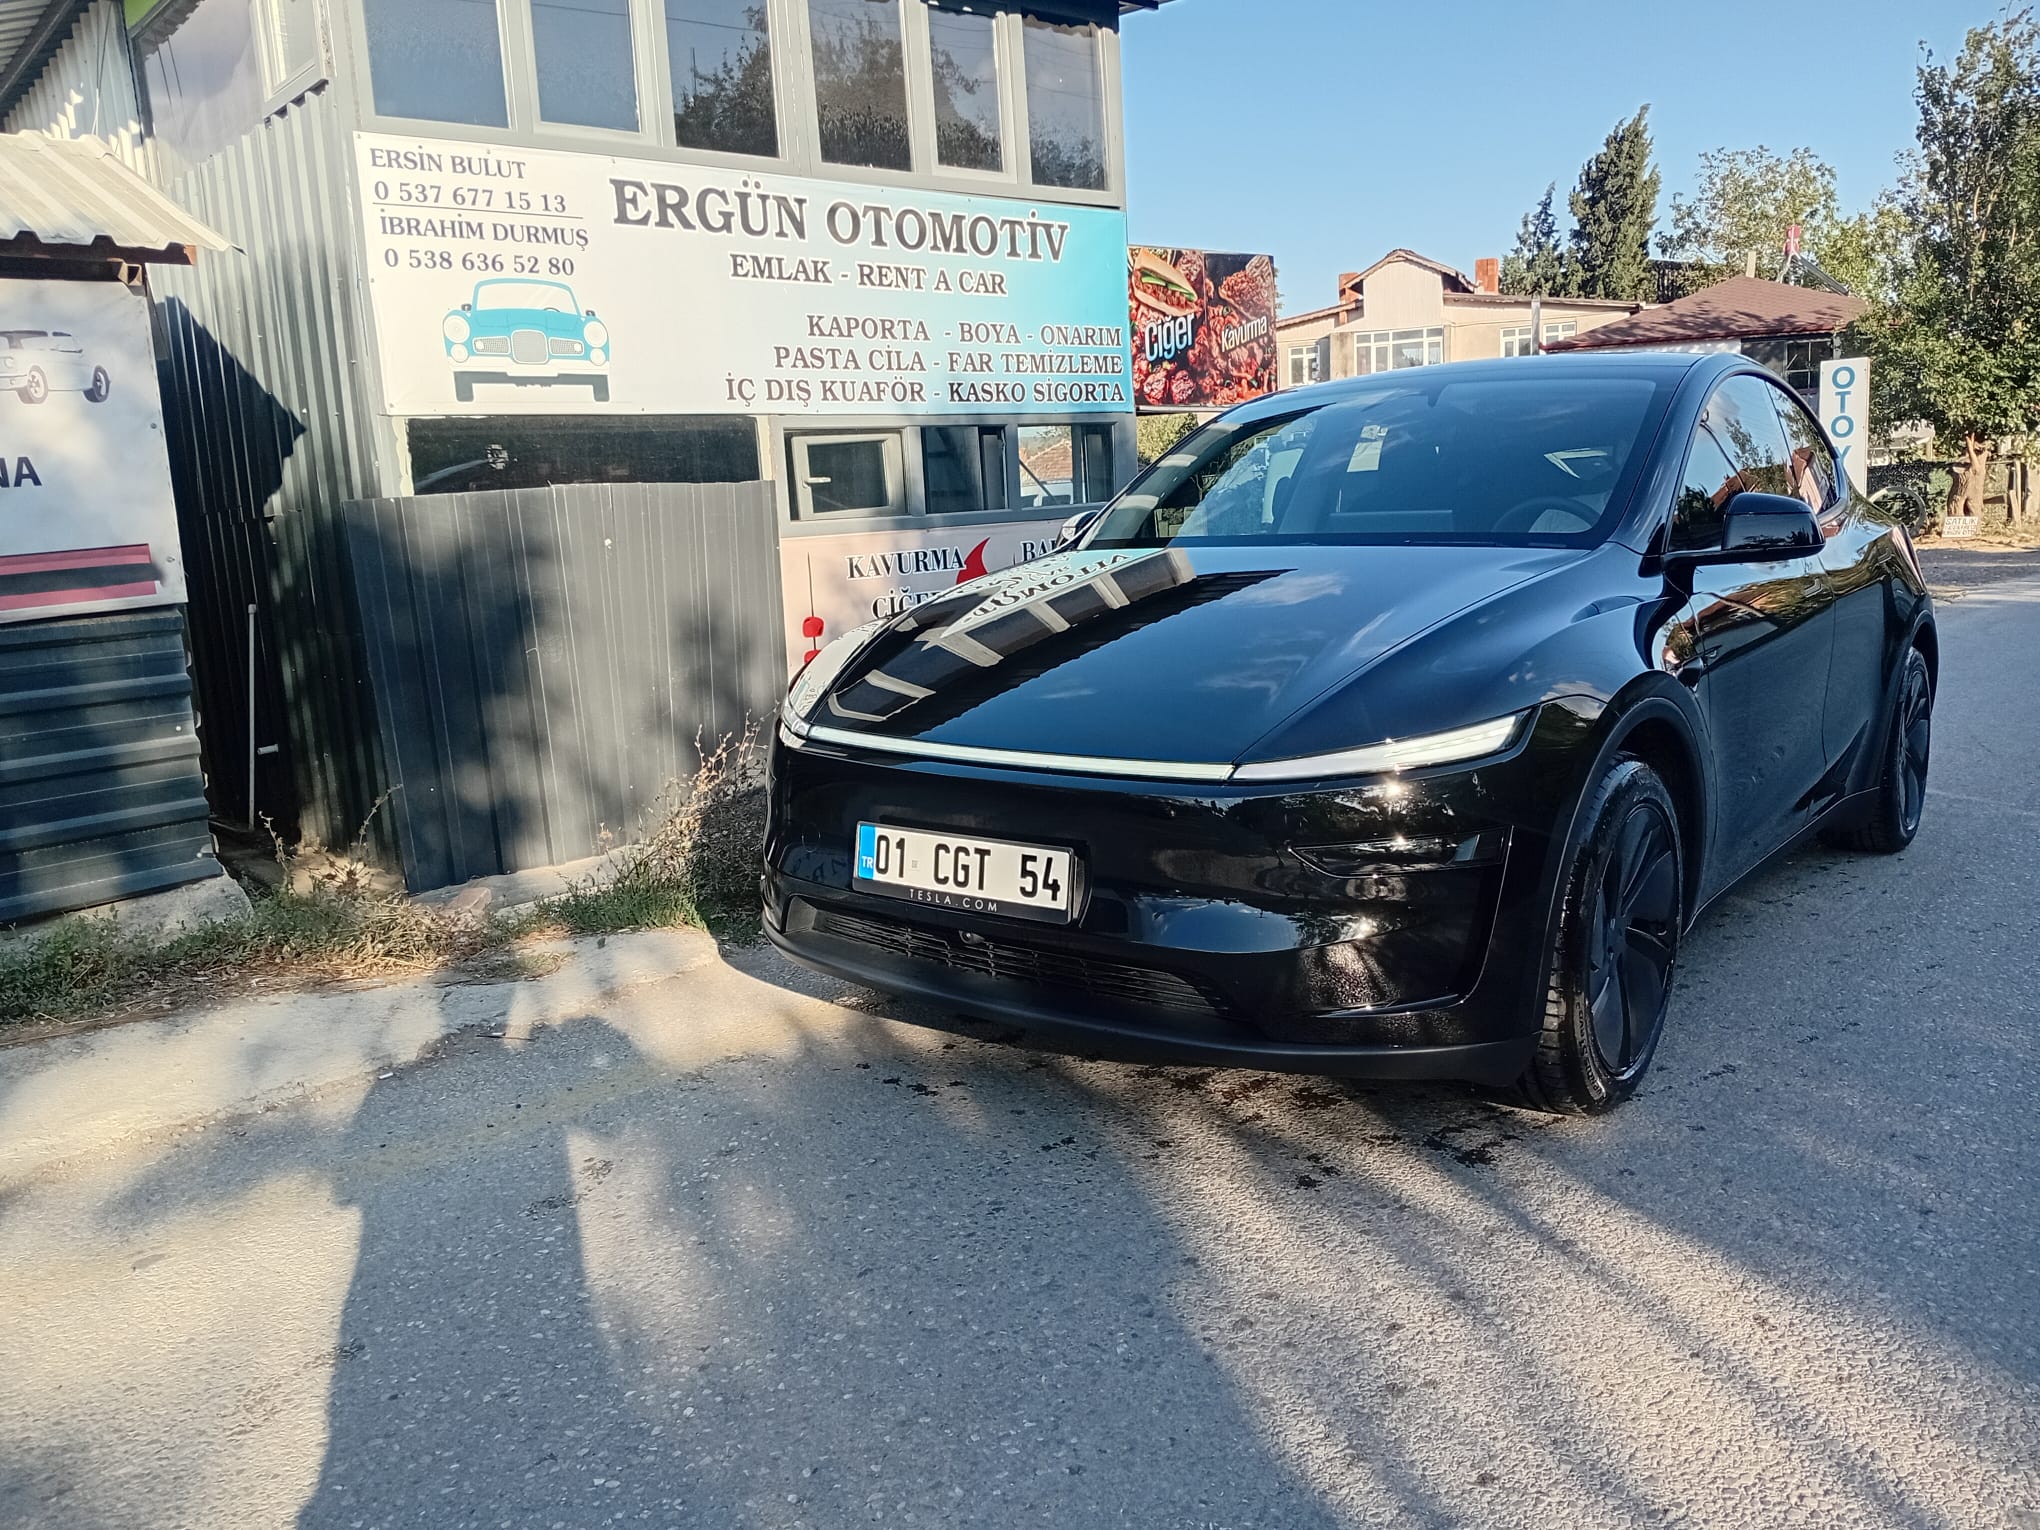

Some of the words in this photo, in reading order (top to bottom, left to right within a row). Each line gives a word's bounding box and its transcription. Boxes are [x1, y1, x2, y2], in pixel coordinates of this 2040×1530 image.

[370, 145, 443, 173] ERSİN
[451, 154, 526, 180] BULUT
[374, 181, 389, 200] 0
[399, 183, 442, 203] 537
[452, 186, 494, 207] 677
[506, 191, 531, 211] 15
[541, 194, 566, 213] 13
[380, 208, 485, 241] İBRAHİM
[493, 221, 589, 251] DURMUŞ
[609, 178, 807, 240] ERGÜN
[827, 200, 1068, 261] OTOMOTİV
[385, 248, 399, 267] 0
[408, 249, 452, 270] 538
[462, 252, 504, 273] 636
[513, 255, 540, 275] 52
[548, 257, 574, 276] 80
[730, 253, 832, 284] EMLAK
[857, 263, 926, 290] RENT
[934, 269, 952, 291] A
[959, 271, 1007, 295] CAR
[807, 315, 930, 341] KAPORTA
[959, 322, 1021, 344] BOYA
[1040, 325, 1121, 347] ONARIM
[1145, 312, 1195, 362] Ciğer
[1222, 315, 1268, 352] Kavurma
[774, 346, 861, 370] PASTA
[869, 345, 926, 371] CİLA
[948, 352, 994, 373] FAR
[1001, 349, 1122, 374] TEMİZLEME
[725, 373, 756, 407] İÇ
[765, 378, 811, 407] DIŞ
[820, 376, 926, 402] KUAFÖR
[948, 382, 1026, 402] KASKO
[1033, 378, 1124, 402] SİGORTA
[846, 546, 965, 580] KAVURMA
[862, 855, 873, 869] TR
[876, 834, 906, 878] 01
[934, 843, 991, 891] CGT
[1020, 854, 1060, 901] 54
[909, 888, 998, 912] TESLA.COM
